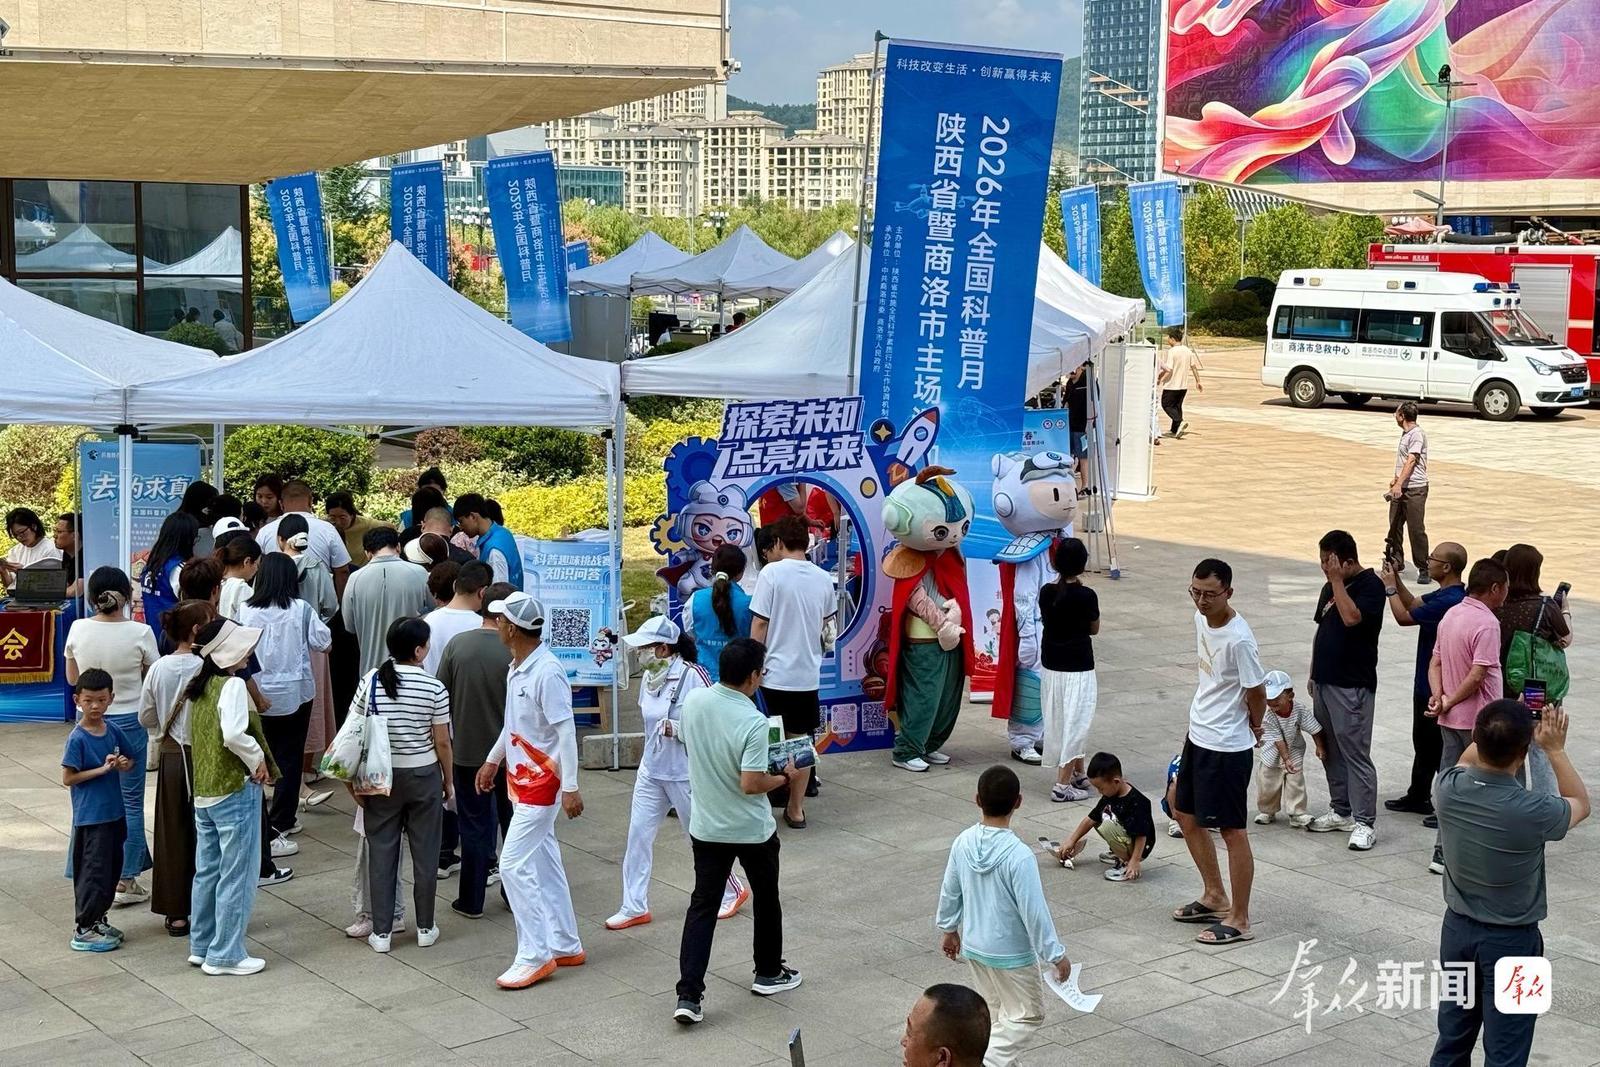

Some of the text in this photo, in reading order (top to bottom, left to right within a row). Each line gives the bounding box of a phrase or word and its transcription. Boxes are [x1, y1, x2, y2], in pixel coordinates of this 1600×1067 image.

[957, 115, 1011, 391] 2026年全国科普月
[912, 112, 967, 464] 陕西省暨商洛市主场
[1288, 341, 1351, 356] 商洛市急救中心
[726, 400, 858, 441] 探索未知
[730, 434, 862, 477] 点亮未来
[545, 568, 602, 581] 知识问答
[0, 627, 29, 661] 会
